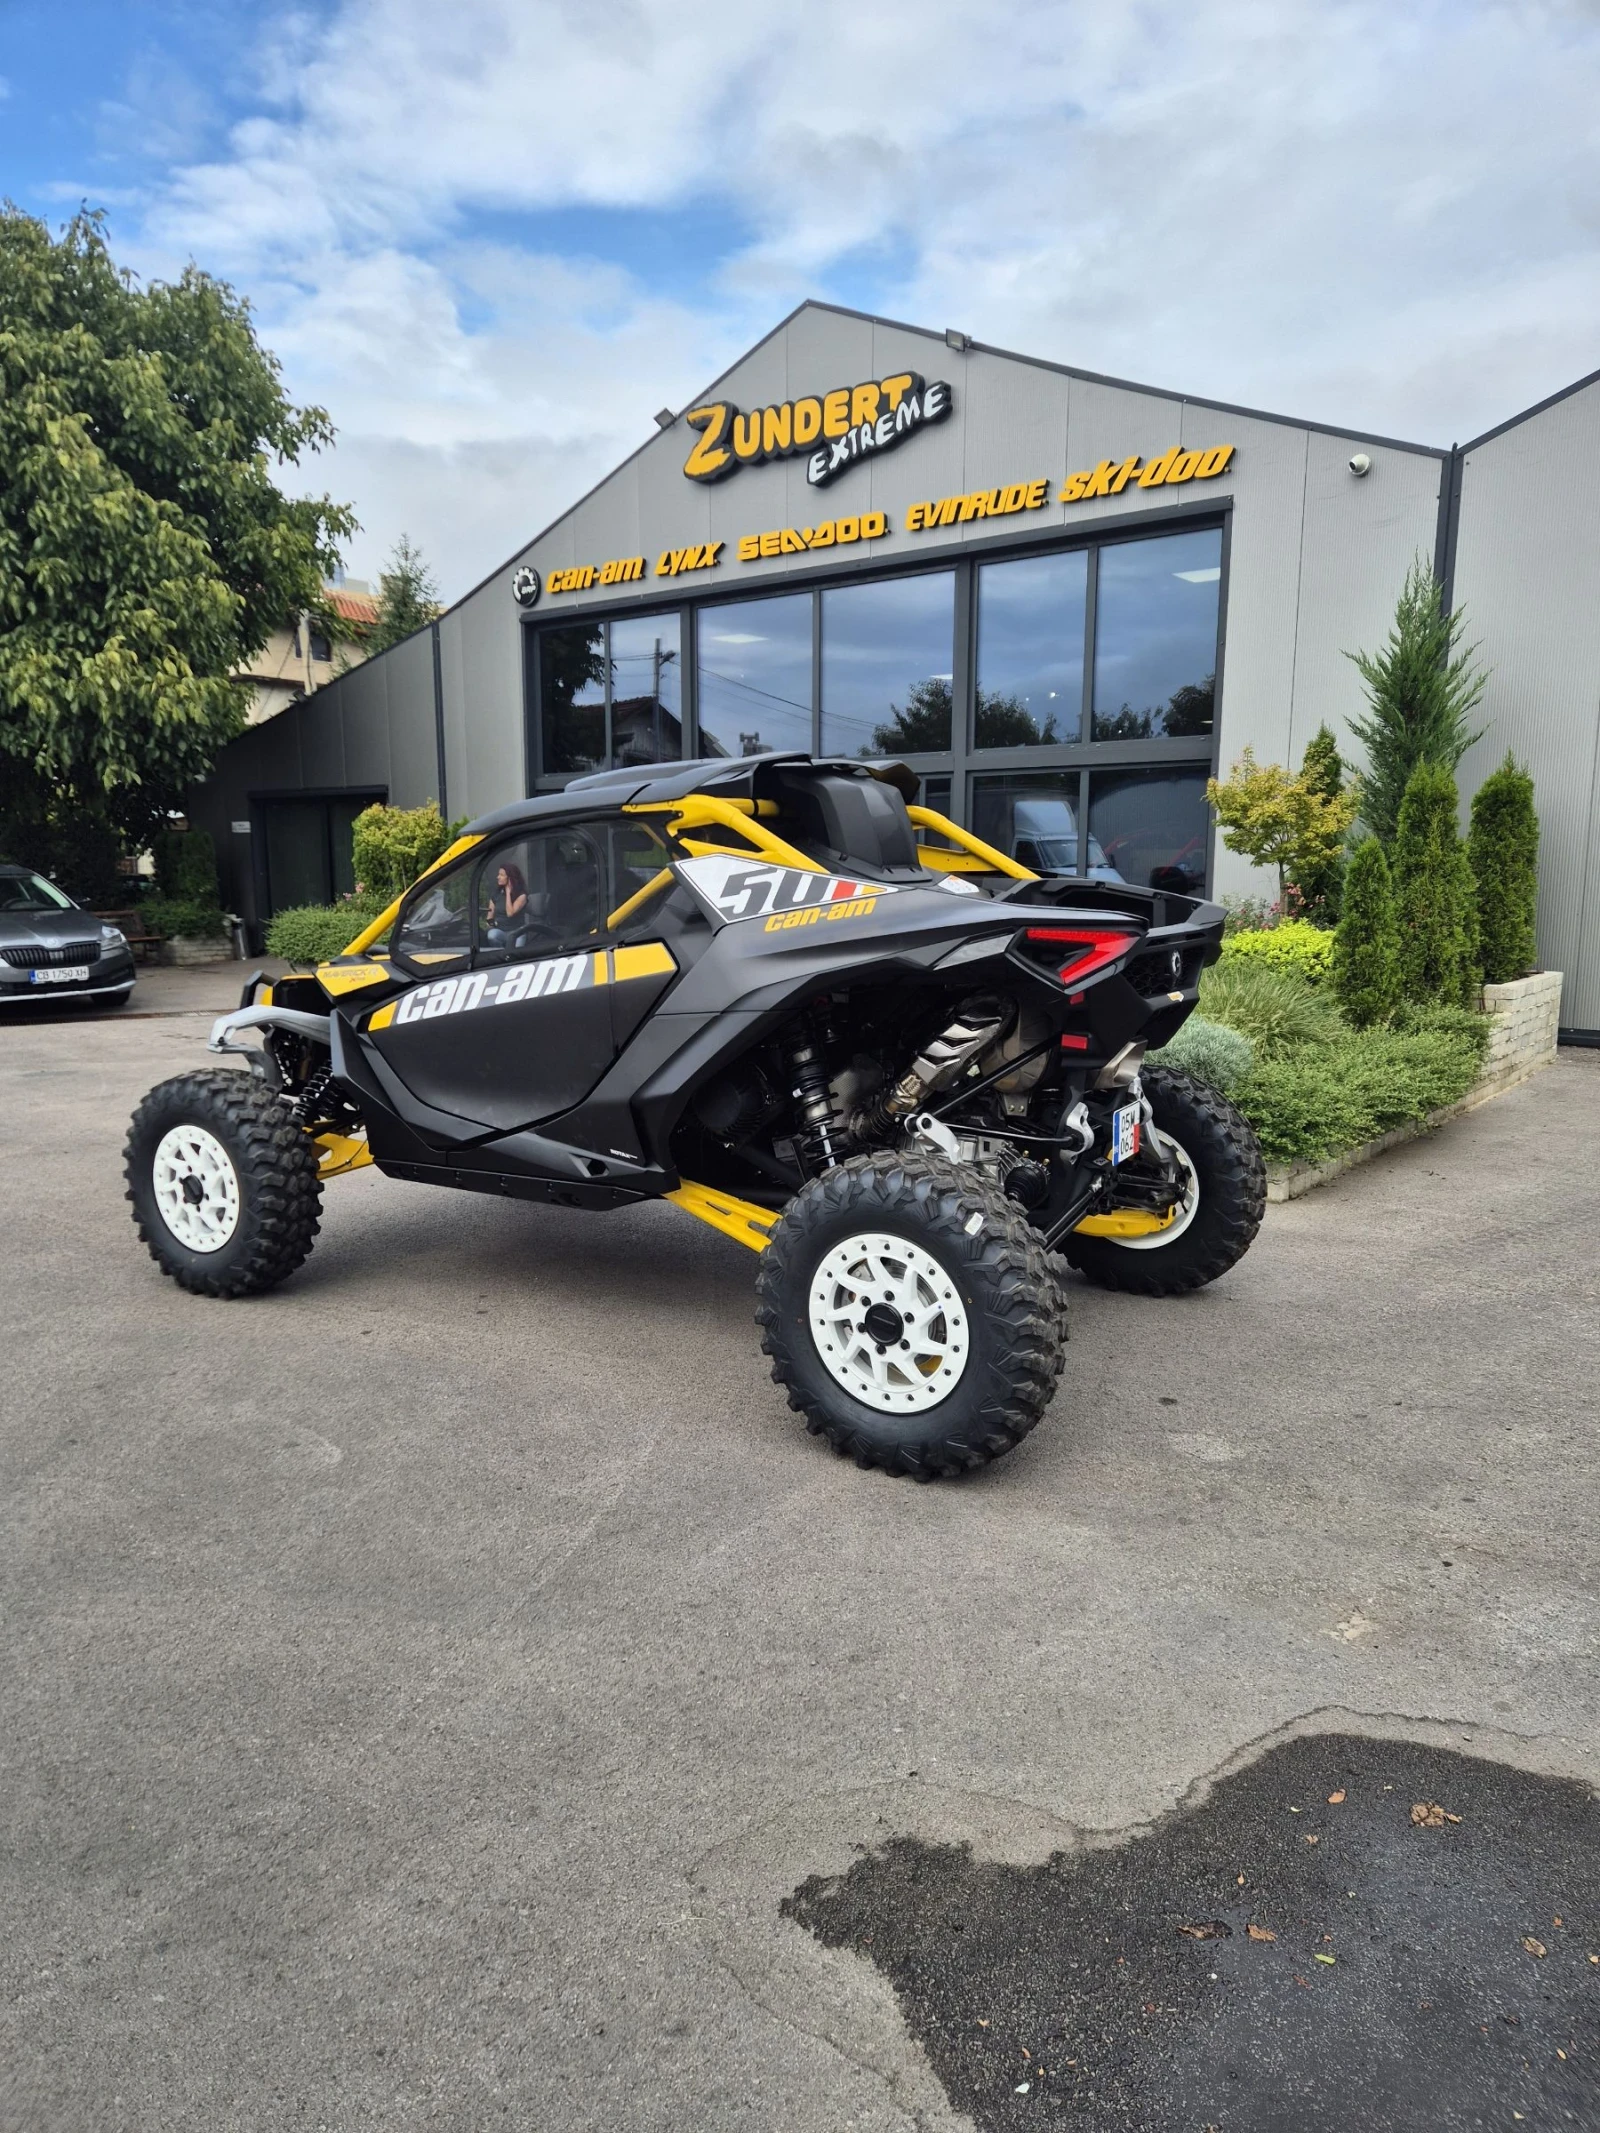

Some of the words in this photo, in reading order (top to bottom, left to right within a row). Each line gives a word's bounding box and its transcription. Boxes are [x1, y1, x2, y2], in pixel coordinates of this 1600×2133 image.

[683, 373, 913, 477] ZUNDERT
[807, 383, 945, 484] EXTREME
[546, 556, 642, 594] can-am
[655, 541, 723, 576] LYNX
[905, 480, 1047, 531] EVINRUDE
[1057, 443, 1235, 503] ski-doo
[764, 898, 877, 933] can-am
[37, 970, 49, 980] CB
[52, 969, 73, 979] 1750
[396, 954, 588, 1025] can-am
